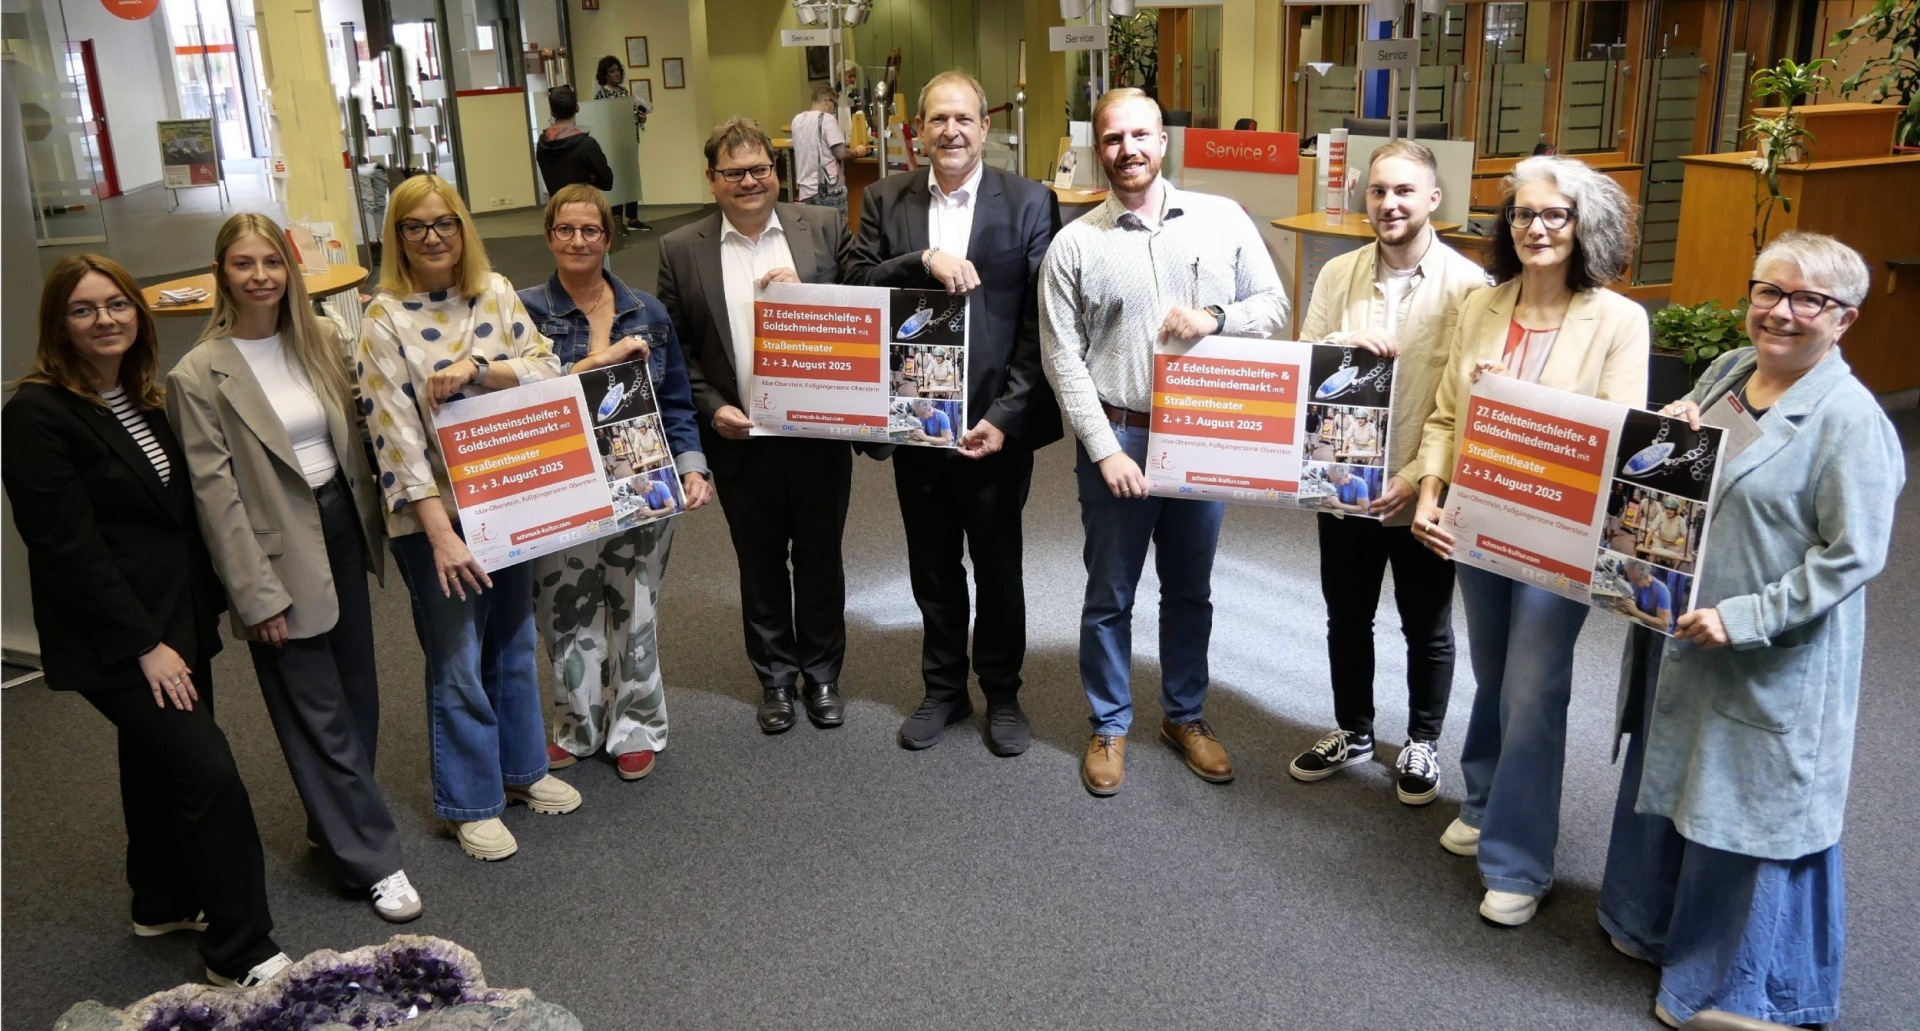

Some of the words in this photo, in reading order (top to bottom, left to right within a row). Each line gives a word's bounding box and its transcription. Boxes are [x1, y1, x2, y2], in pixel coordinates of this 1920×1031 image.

[1065, 34, 1094, 43] Service
[1378, 50, 1408, 61] Service
[1205, 141, 1263, 160] Service
[1267, 144, 1277, 162] 2
[762, 309, 774, 318] 27.
[776, 309, 862, 323] Edelsteinschleifer-
[865, 314, 873, 324] &
[763, 321, 857, 335] Goldschmiedemarkt
[762, 340, 834, 353] Straßentheater
[762, 357, 770, 366] 2.
[781, 358, 790, 367] 3.
[792, 359, 826, 371] August
[828, 361, 852, 371] 2025
[1166, 362, 1180, 371] 27.
[1183, 363, 1278, 379] Edelsteinschleifer-
[1281, 371, 1290, 381] &
[1165, 375, 1271, 393] Goldschmiedemarkt
[1272, 386, 1285, 394] mit
[1164, 395, 1244, 411] Straßentheater
[454, 431, 469, 442] 27.
[470, 410, 561, 438] Edelsteinschleifer-
[563, 405, 571, 415] &
[1162, 413, 1172, 424] 2.
[1184, 415, 1194, 425] 3.
[1196, 416, 1235, 430] August
[1237, 420, 1263, 431] 2025
[1476, 405, 1489, 418] 27.
[1491, 409, 1585, 443] Edelsteinschleifer-
[1588, 435, 1598, 447] &
[458, 422, 559, 454] Goldschmiedemarkt
[559, 422, 571, 430] mit
[1473, 420, 1577, 458] Goldschmiedemarkt
[1577, 452, 1590, 462] mit
[1260, 446, 1292, 455] Oberstein
[1467, 443, 1546, 475] Straßentheater
[463, 449, 541, 476] Straßentheater
[468, 484, 480, 494] 2.
[481, 483, 489, 491] +
[490, 478, 501, 489] 3.
[502, 468, 539, 486] August
[539, 461, 564, 475] 2025
[568, 477, 597, 490] Oberstein
[1191, 475, 1250, 486] schmuck-kultur.com
[1462, 463, 1472, 475] 2.
[1474, 469, 1481, 477] +
[1482, 470, 1492, 482] 3.
[1494, 473, 1533, 494] August
[1535, 485, 1563, 502] 2025
[516, 521, 572, 541] schmuck-kultur.com
[1555, 521, 1589, 538] Oberstein
[1482, 540, 1540, 564] schmuck-kultur.com
